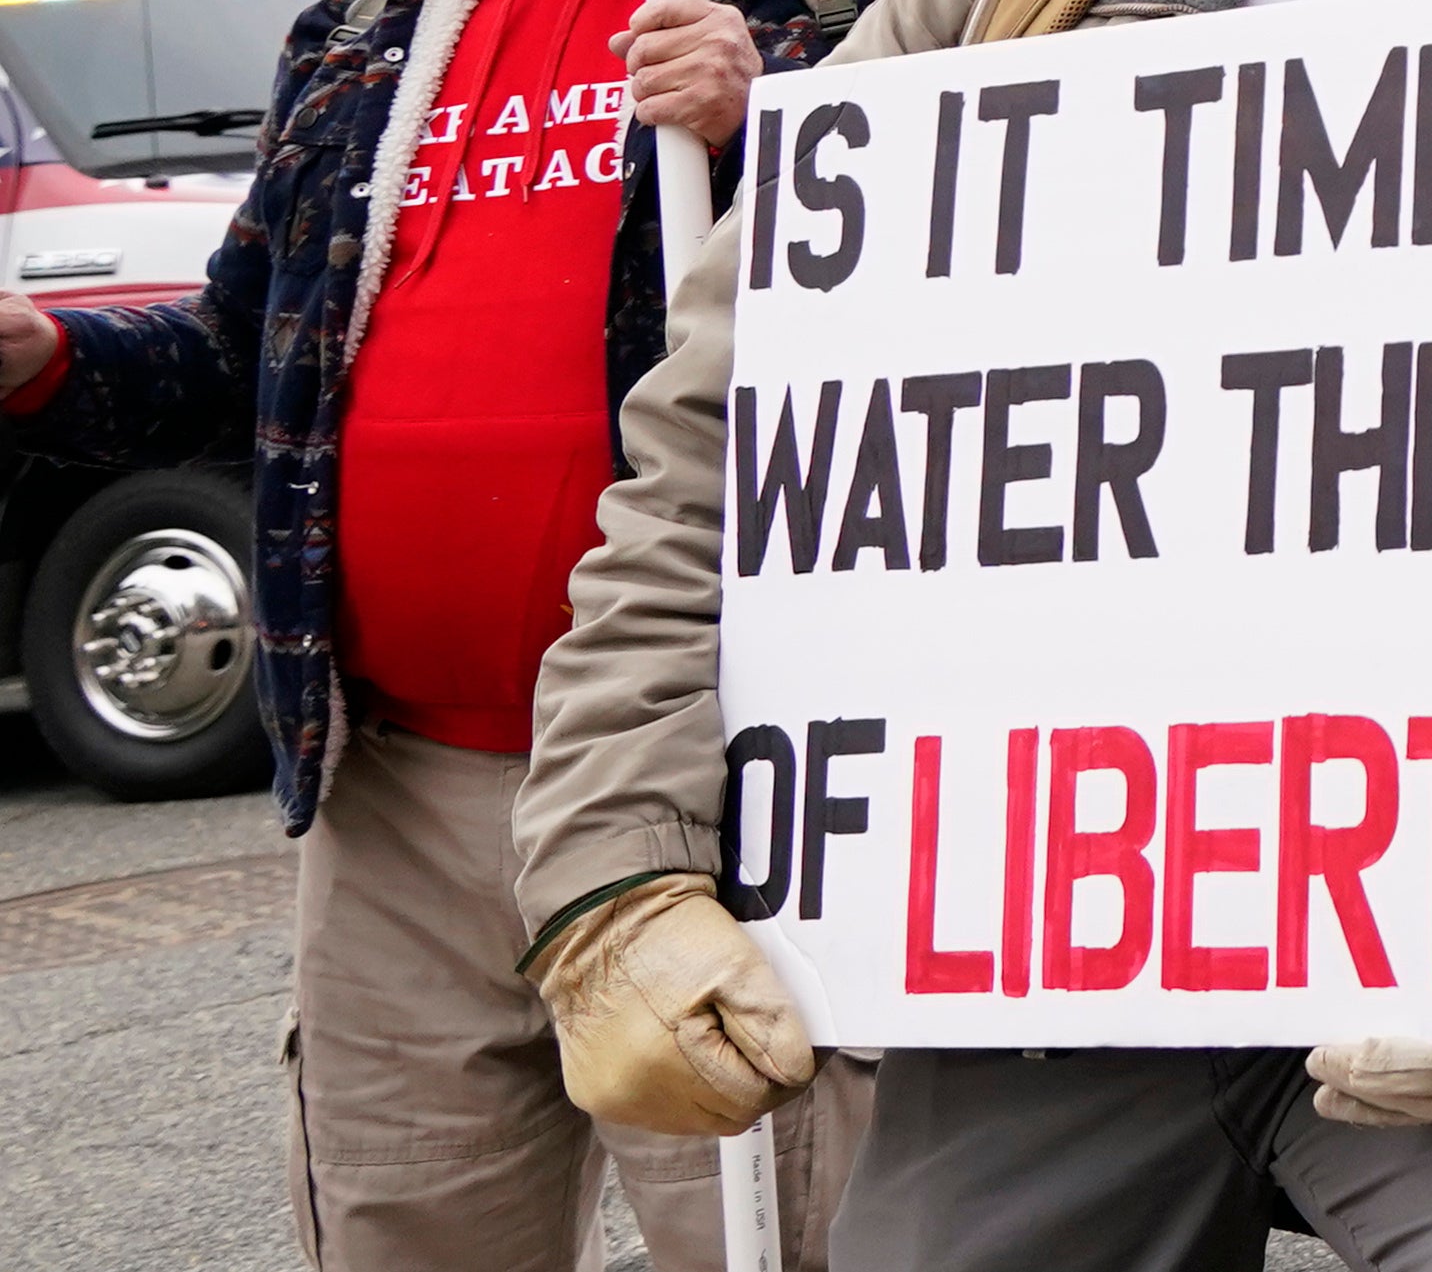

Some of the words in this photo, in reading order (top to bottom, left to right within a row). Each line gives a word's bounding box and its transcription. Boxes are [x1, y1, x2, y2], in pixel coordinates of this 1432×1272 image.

[749, 102, 870, 295] IS
[926, 80, 1060, 280] IT
[734, 358, 1168, 580] WATER
[723, 717, 886, 924] OF
